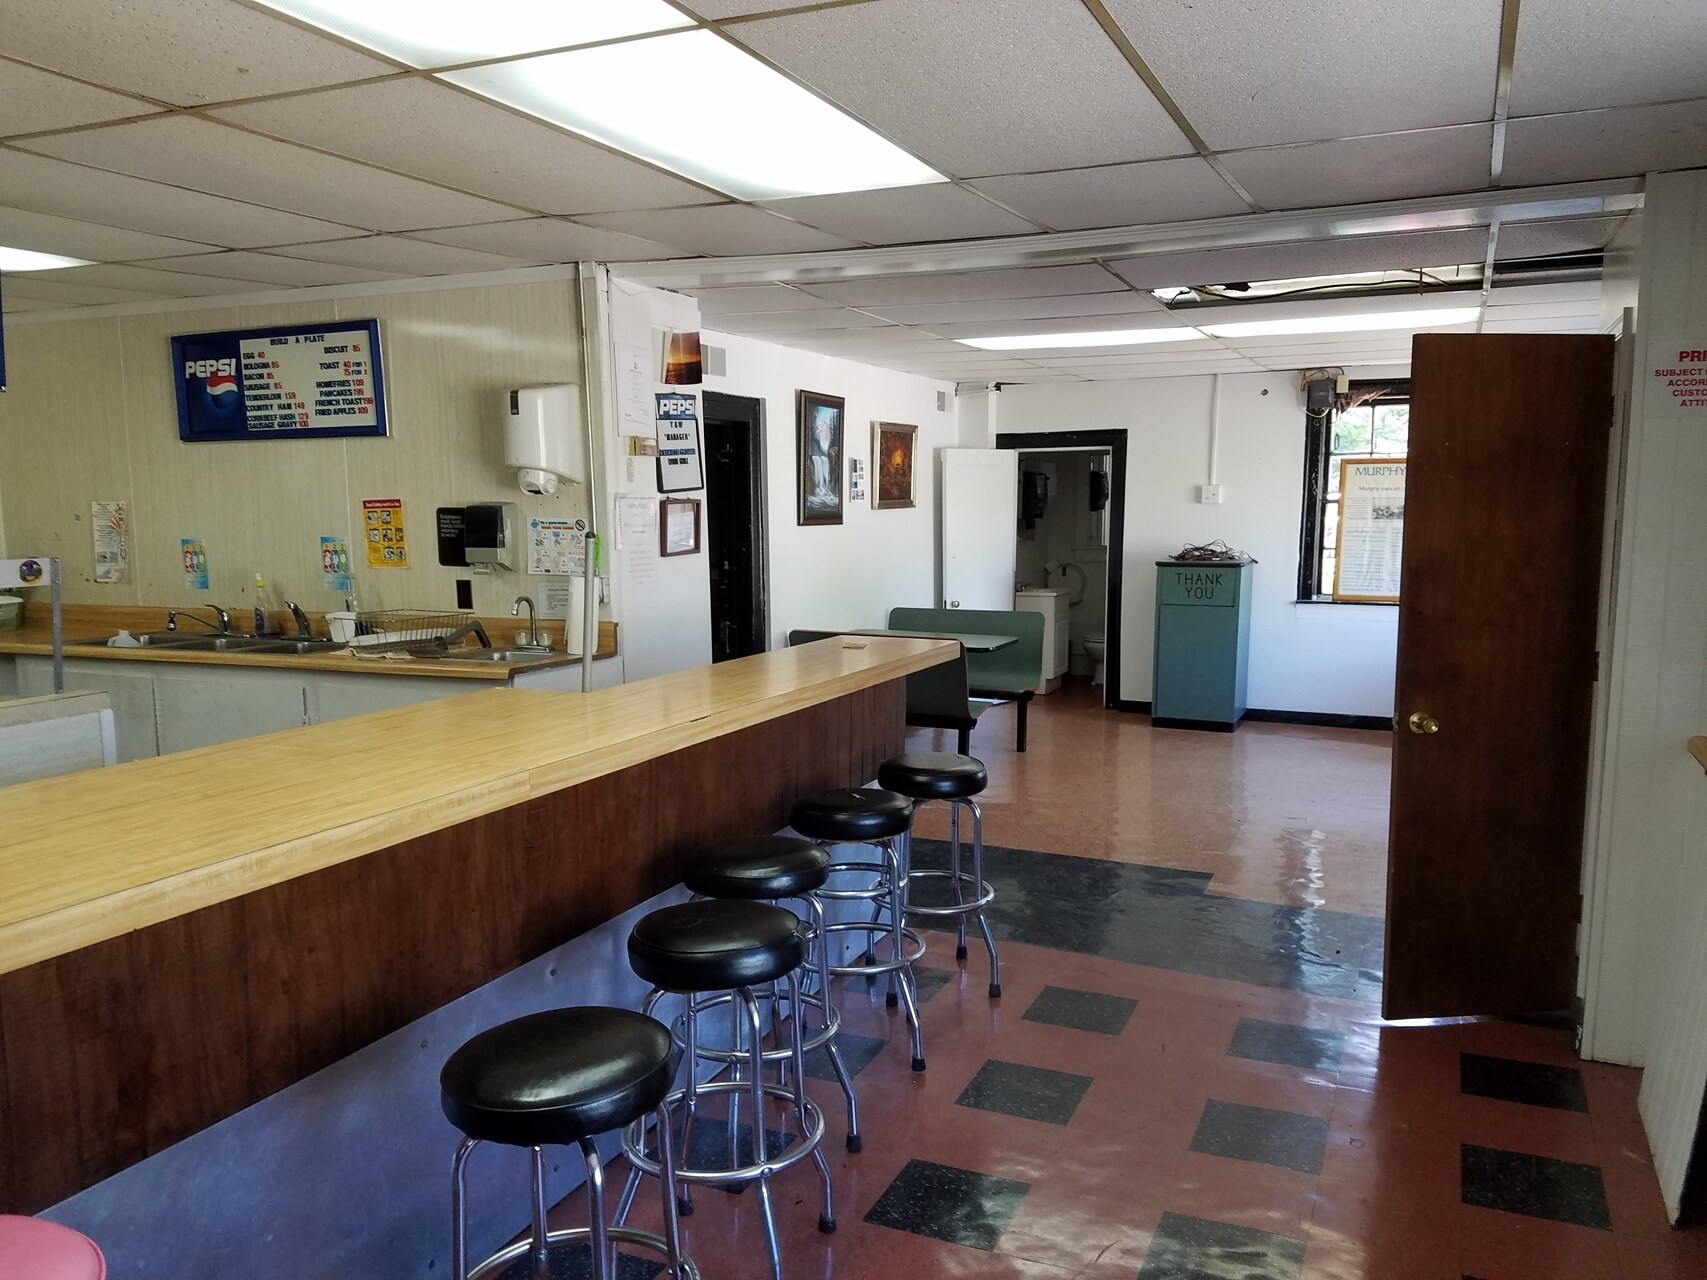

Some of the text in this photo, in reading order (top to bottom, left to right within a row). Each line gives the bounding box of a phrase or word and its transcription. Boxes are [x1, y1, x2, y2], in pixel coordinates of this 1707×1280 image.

[270, 338, 289, 346] BUILD
[304, 335, 326, 343] PLATE
[324, 344, 361, 354] BISCUIT 85
[243, 351, 266, 360] EGG 40
[1678, 350, 1707, 362] PRI
[185, 358, 236, 378] PEPSI
[243, 360, 280, 370] BOLOGNA 85
[319, 361, 340, 370] TOAST
[343, 360, 351, 368] 40
[244, 371, 275, 381] BACON 85
[1654, 368, 1704, 377] SUBJECT
[244, 383, 271, 391] SAUSAGE
[315, 379, 351, 388] HOMEFRIES
[1667, 378, 1707, 387] ACCOR
[245, 391, 296, 401] TENDERLOIN 159
[319, 389, 353, 397] PANCAKES
[246, 403, 273, 412] COUNTRY
[277, 402, 293, 410] HAM
[315, 399, 341, 407] FRENCH
[342, 397, 363, 406] TOAST
[315, 408, 332, 416] FRIED
[333, 406, 357, 415] APPLES
[279, 413, 296, 421] HASH
[248, 421, 275, 430] SAUSAGE
[277, 420, 297, 428] GRAVY
[1175, 572, 1223, 586] THANK
[1184, 586, 1214, 600] YOU
